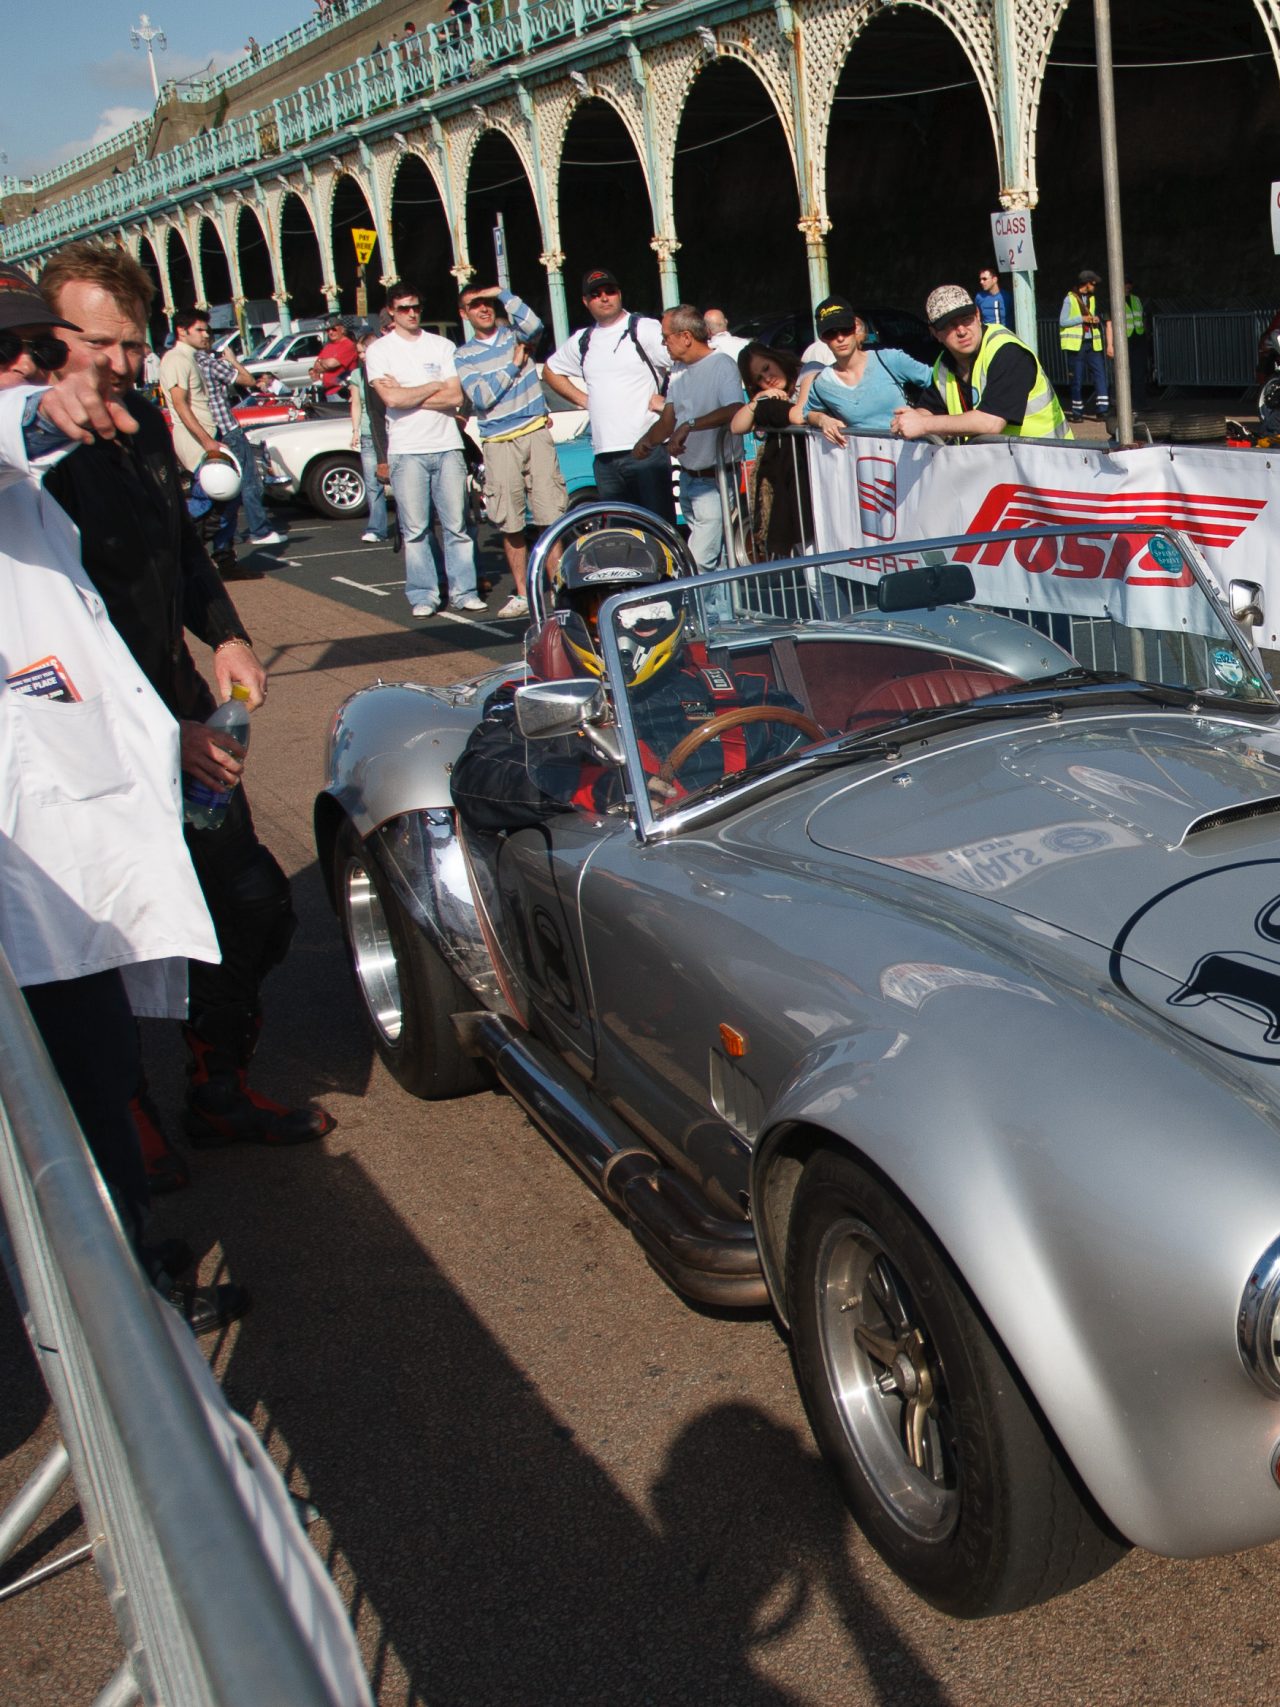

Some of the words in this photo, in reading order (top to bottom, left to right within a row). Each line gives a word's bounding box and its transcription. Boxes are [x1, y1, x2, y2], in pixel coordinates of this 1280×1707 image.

[995, 216, 1026, 236] CLASS
[1008, 248, 1015, 265] 2
[32, 677, 58, 690] PLACE
